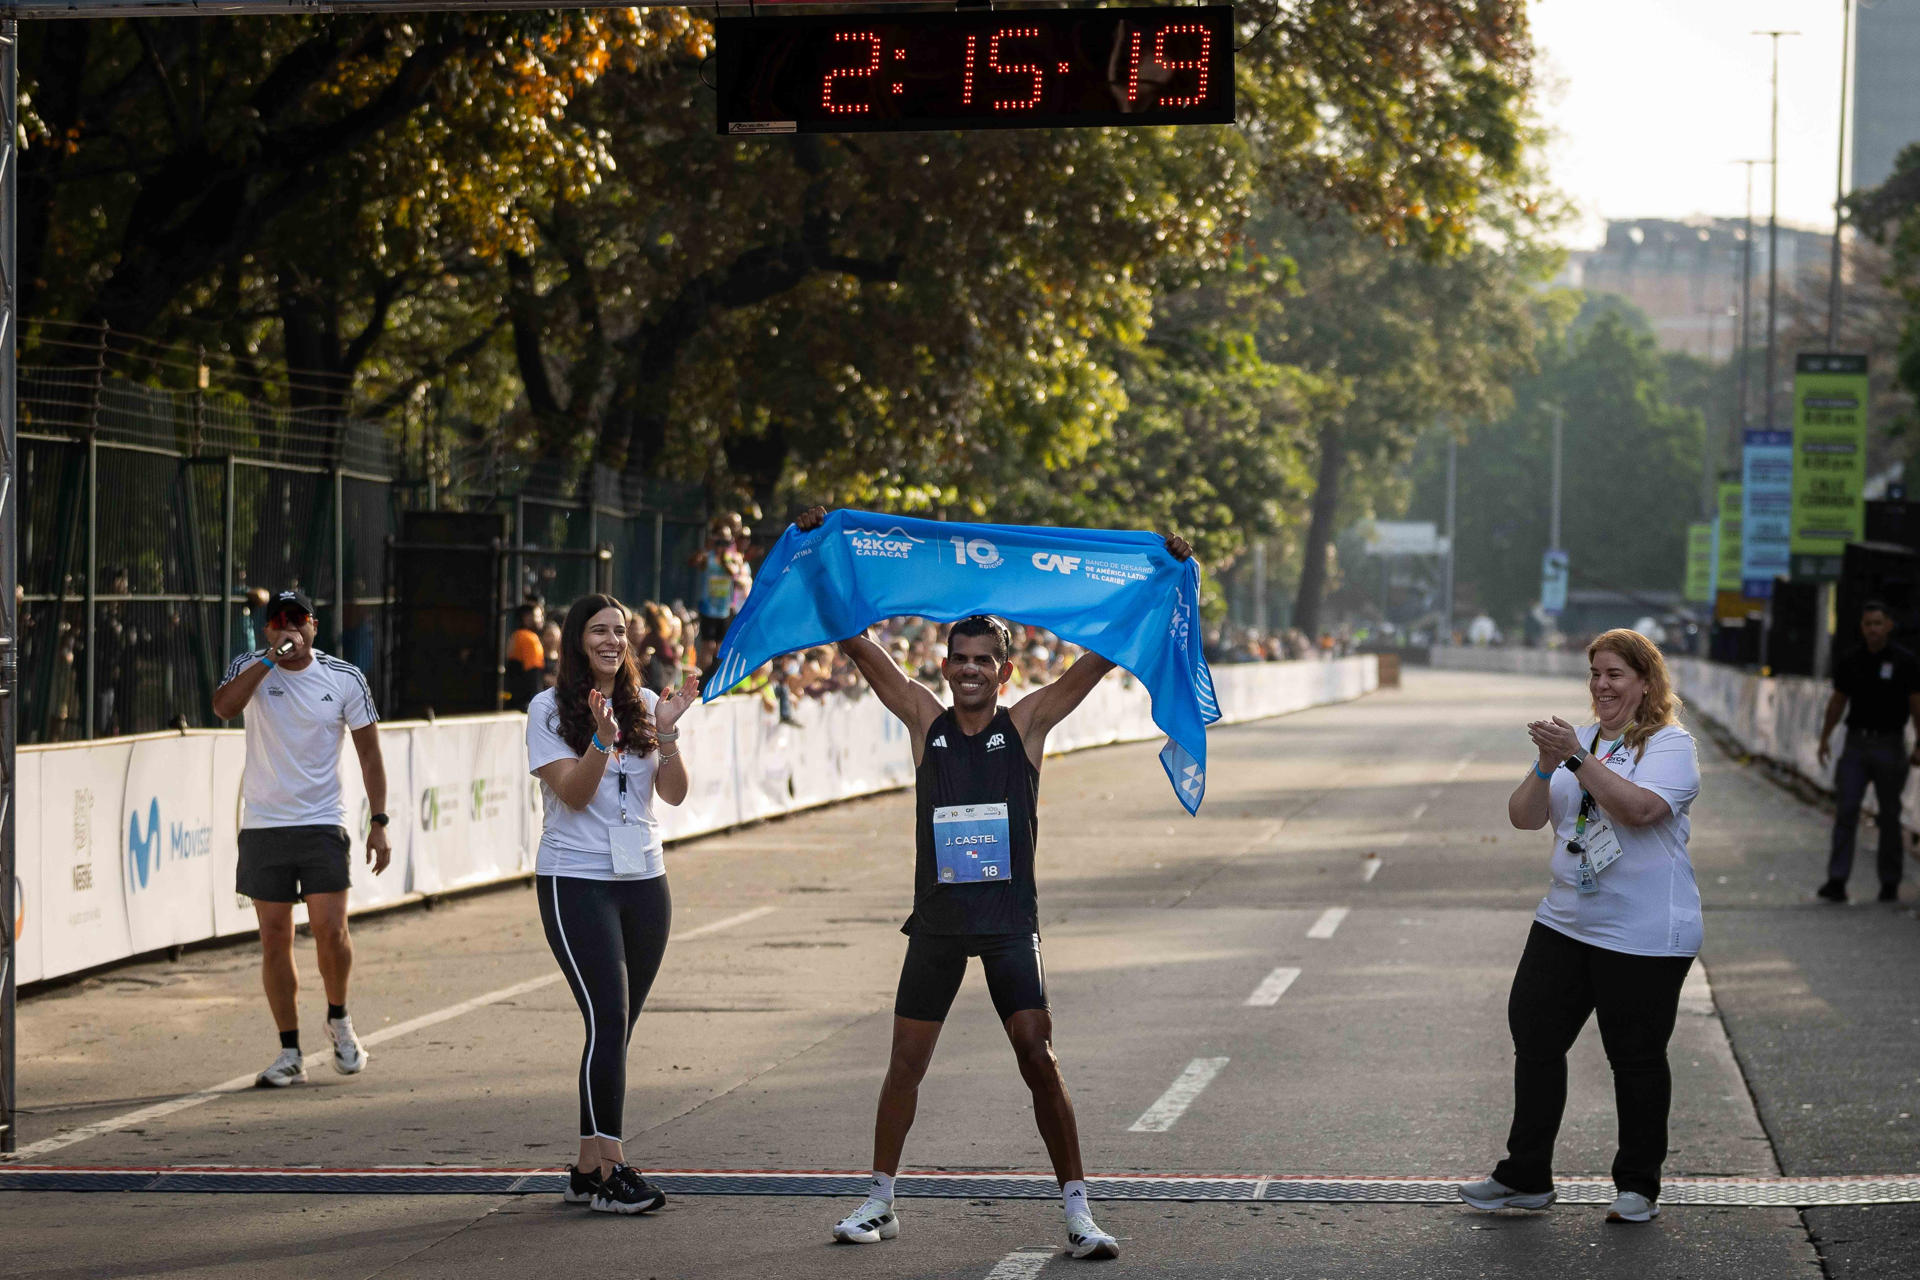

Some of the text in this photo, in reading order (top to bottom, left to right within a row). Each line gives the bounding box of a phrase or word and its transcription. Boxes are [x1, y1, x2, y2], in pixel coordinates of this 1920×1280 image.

[855, 549, 909, 559] CARACAS
[950, 535, 999, 565] 10
[1031, 552, 1082, 575] CAF
[1085, 559, 1108, 568] BANCO
[1096, 566, 1127, 578] AMÉRICA
[1101, 574, 1125, 585] CARIBE
[945, 835, 998, 846] J. CASTEL
[982, 865, 998, 877] 18
